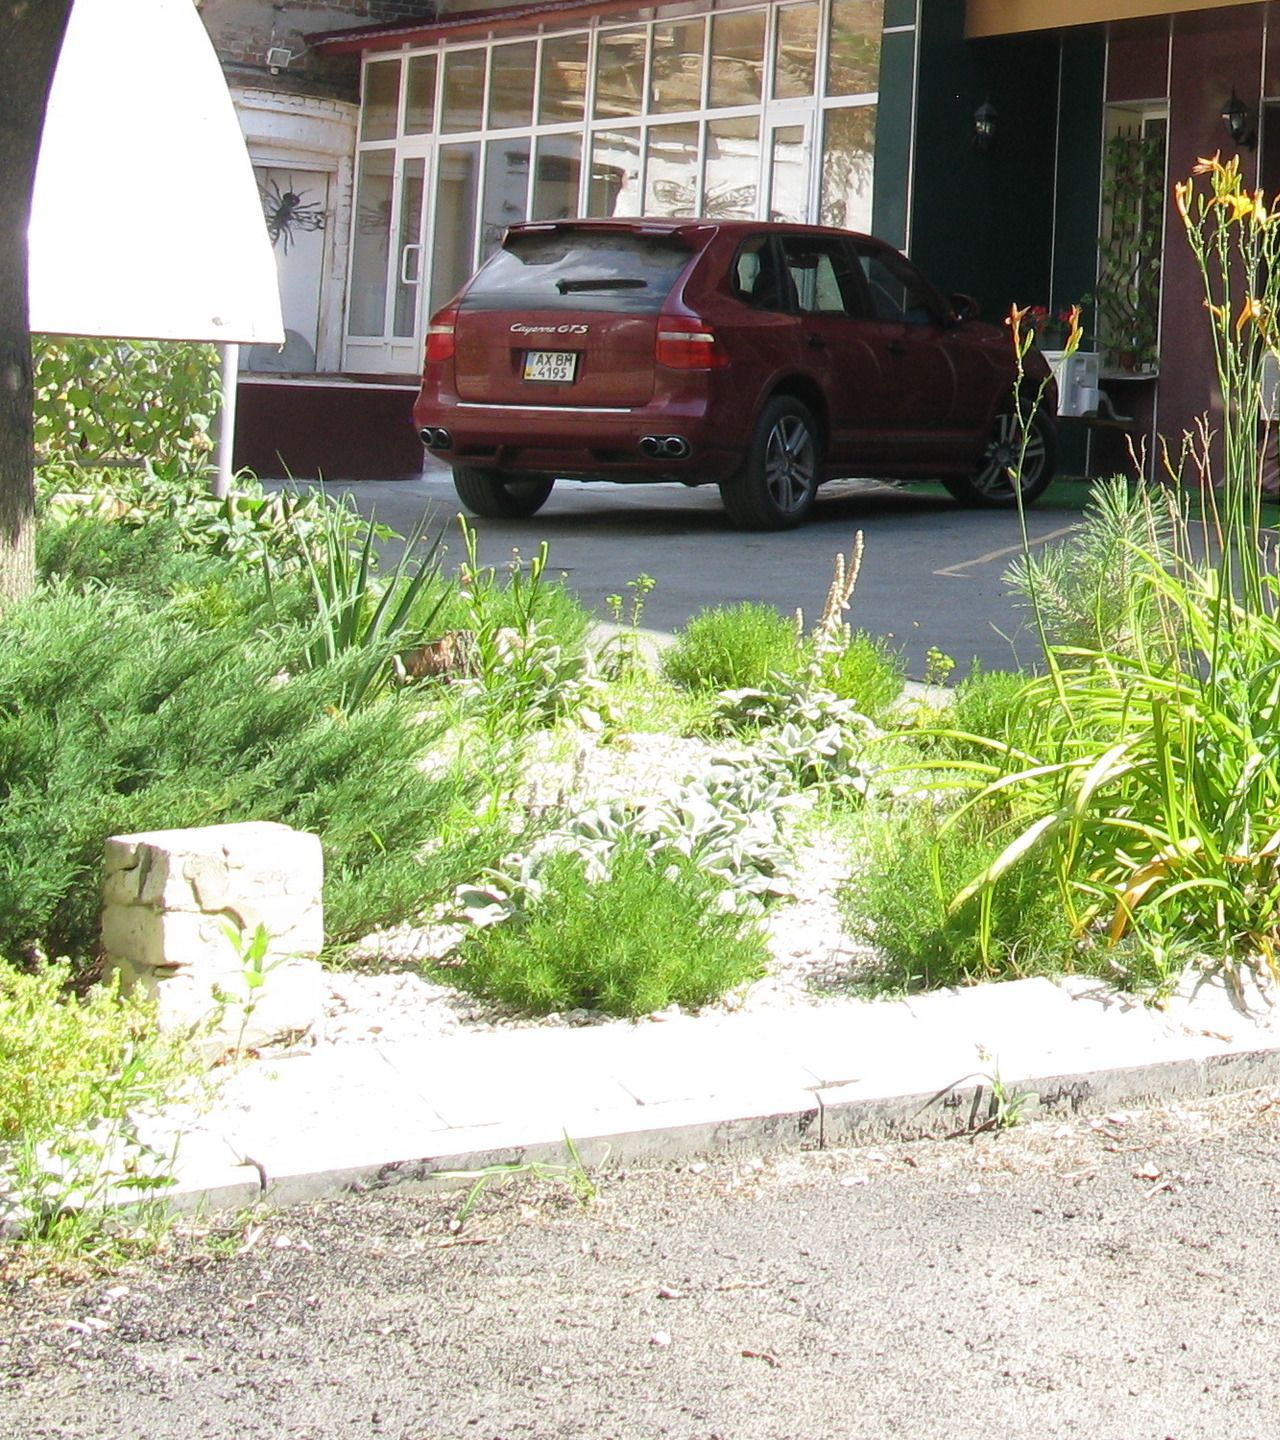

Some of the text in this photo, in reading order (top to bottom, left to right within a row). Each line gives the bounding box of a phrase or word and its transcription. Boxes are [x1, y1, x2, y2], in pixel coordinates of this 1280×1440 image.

[510, 323, 589, 335] Cayenne GTS
[535, 354, 553, 366] AX
[538, 367, 567, 379] 4195
